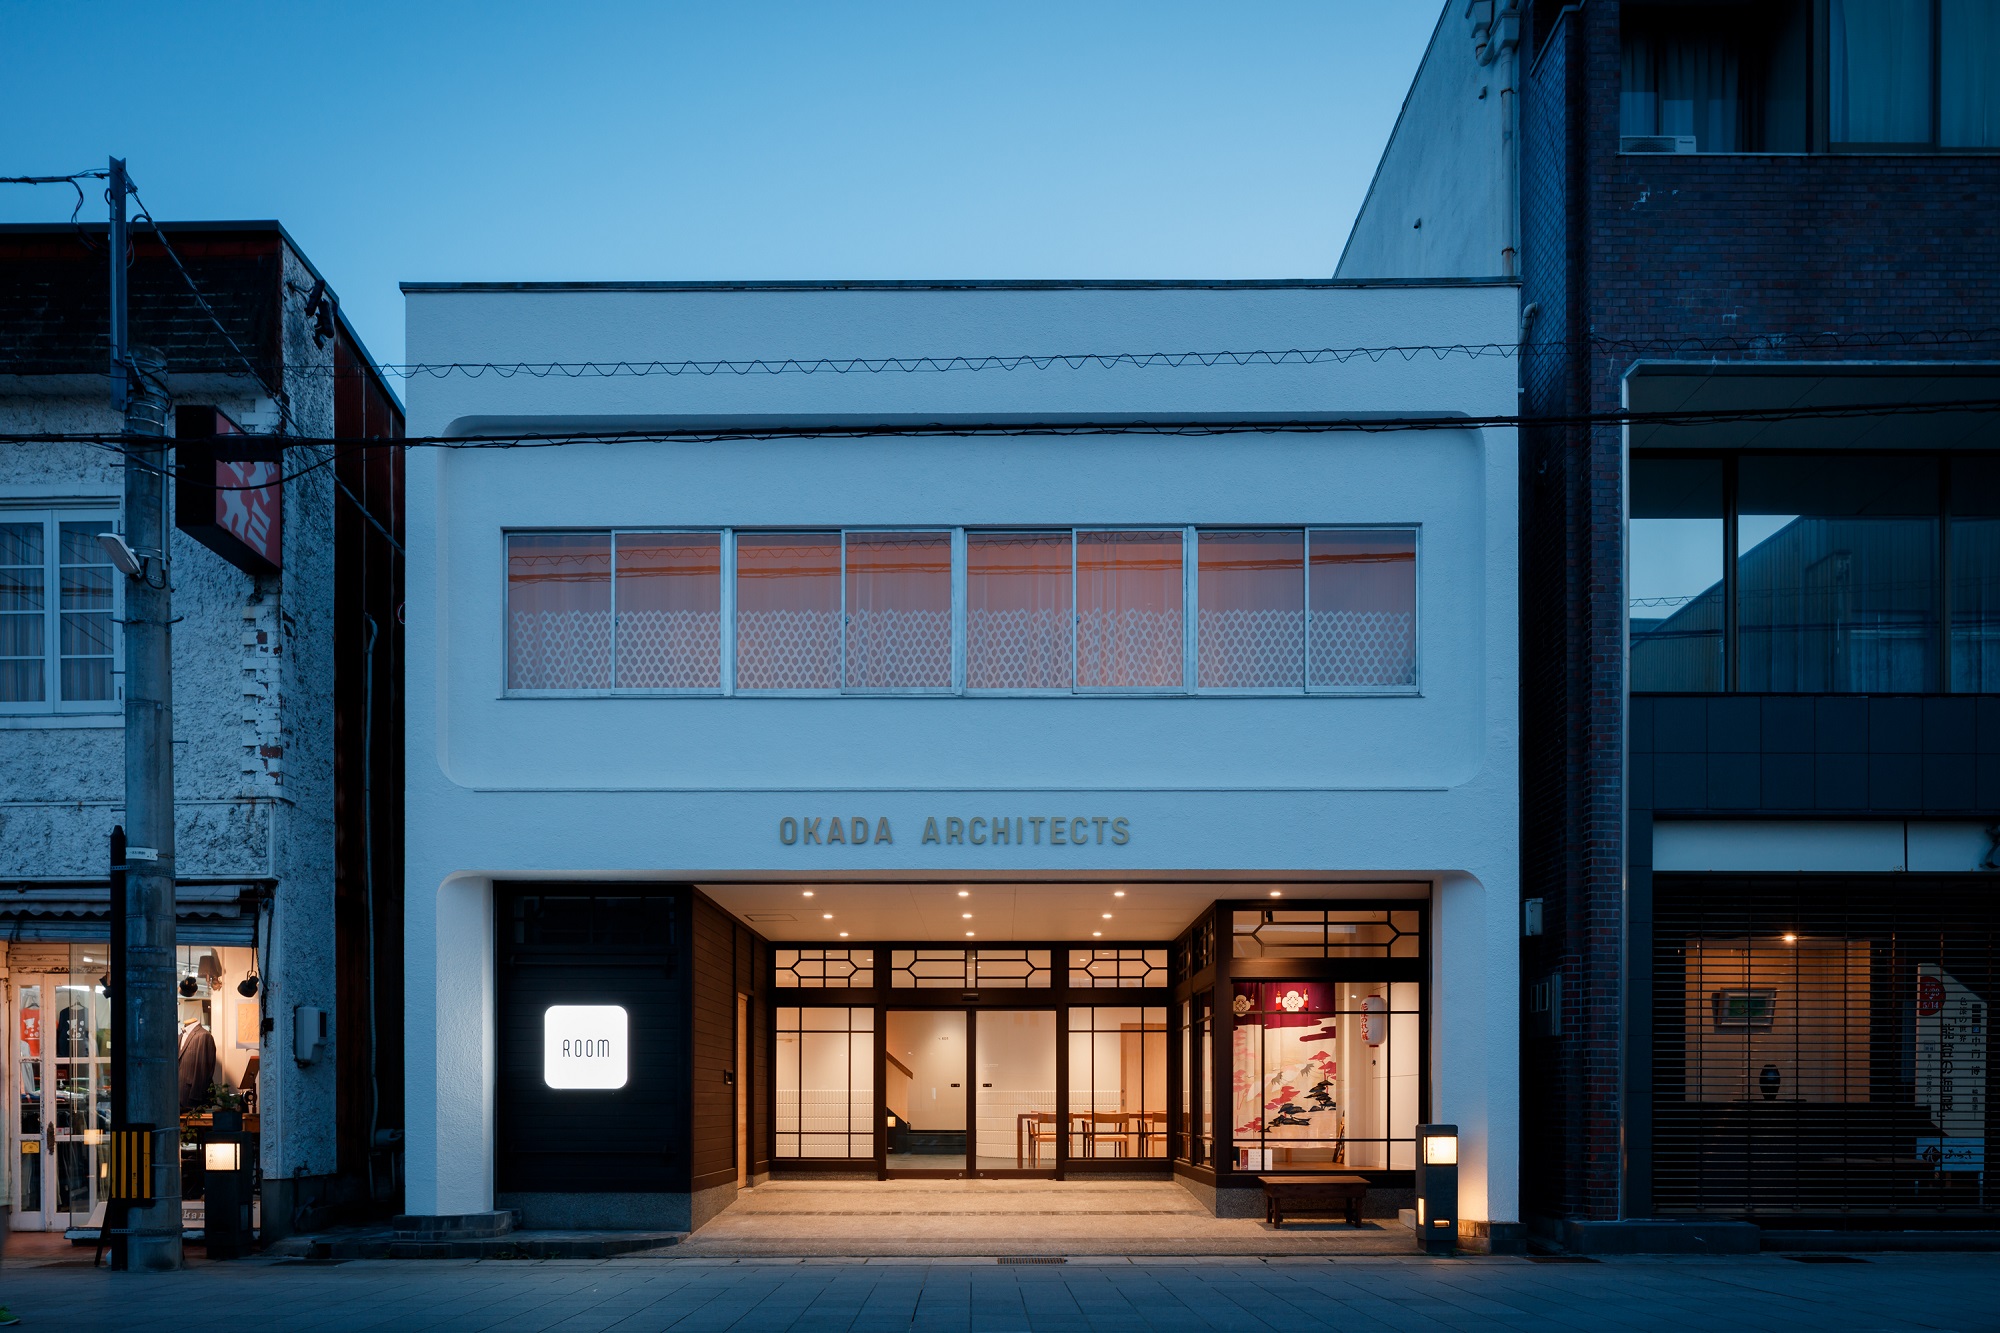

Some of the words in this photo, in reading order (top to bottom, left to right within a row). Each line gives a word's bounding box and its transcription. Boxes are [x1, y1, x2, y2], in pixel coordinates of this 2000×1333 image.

[779, 816, 893, 845] OKADA
[921, 816, 1131, 845] ARCHITECTS
[562, 1038, 610, 1058] ROOM
